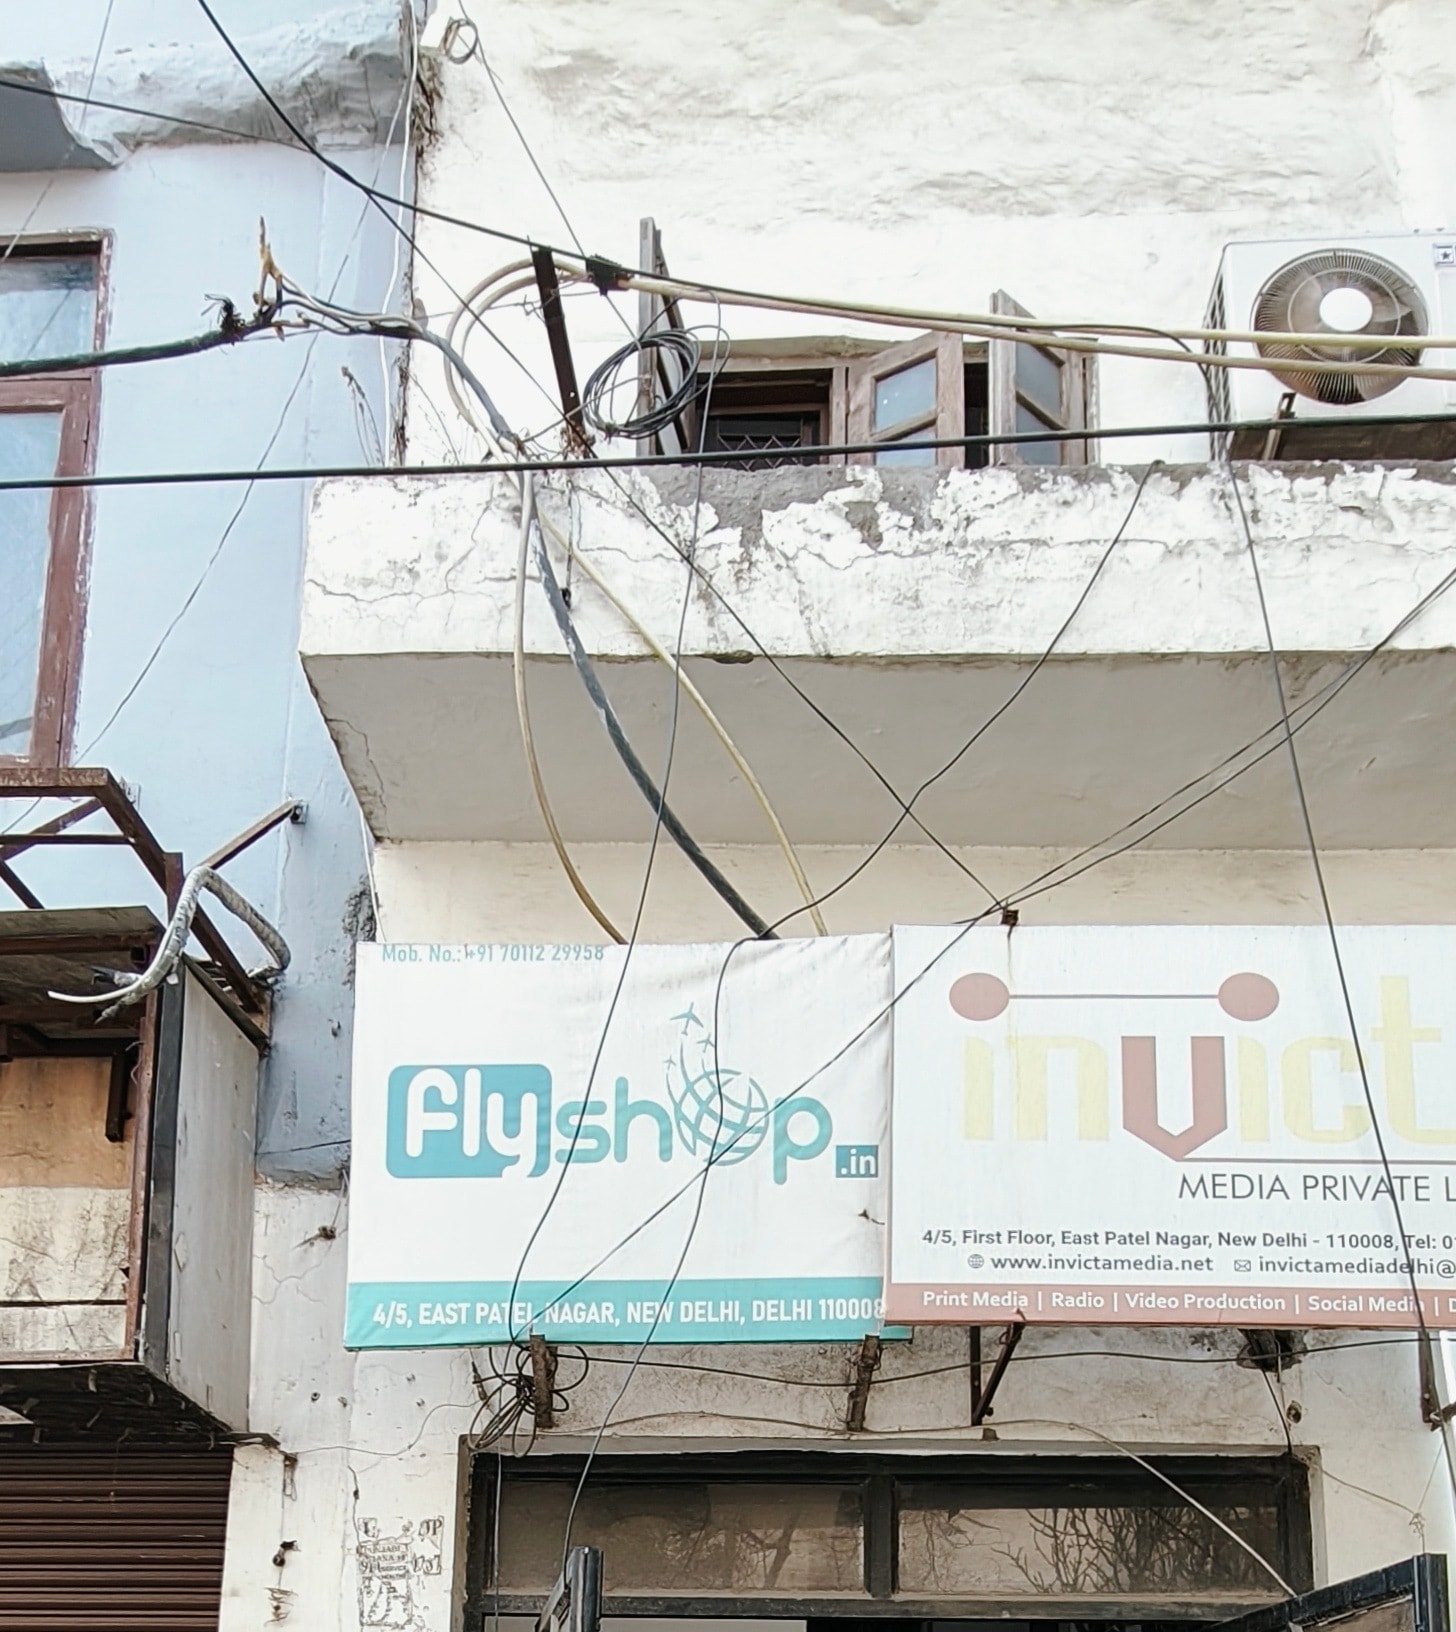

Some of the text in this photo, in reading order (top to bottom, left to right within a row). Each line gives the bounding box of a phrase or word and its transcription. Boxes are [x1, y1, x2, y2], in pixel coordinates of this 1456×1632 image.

[382, 944, 422, 962] Mob.
[428, 945, 461, 962] No.:
[501, 945, 545, 962] 70112
[551, 944, 605, 961] 29958
[1178, 1173, 1291, 1201] MEDIA
[1302, 1174, 1431, 1202] PRIVATE
[922, 1230, 957, 1247] 4/5,
[962, 1230, 1002, 1245] First
[1007, 1230, 1056, 1248] Floor,
[1061, 1230, 1100, 1246] East
[1105, 1231, 1150, 1246] Patel
[1156, 1231, 1212, 1249] Nagar,
[1217, 1232, 1257, 1247] New
[1262, 1233, 1308, 1248] Delhi
[1326, 1234, 1399, 1251] 110008,
[1405, 1234, 1437, 1249] Tel:
[990, 1254, 1214, 1272] www.invictamedia.net
[1258, 1256, 1456, 1278] invictamediadelhi@
[922, 1290, 968, 1307] Print
[973, 1291, 1029, 1308] Media
[1051, 1292, 1105, 1309] Radio
[1125, 1292, 1179, 1310] Video
[1184, 1294, 1286, 1311] Production
[1308, 1295, 1363, 1312] Social
[372, 1298, 885, 1329] 4/5, EAST PATEL NAGAR, NEW DELHI, DELHI 110008
